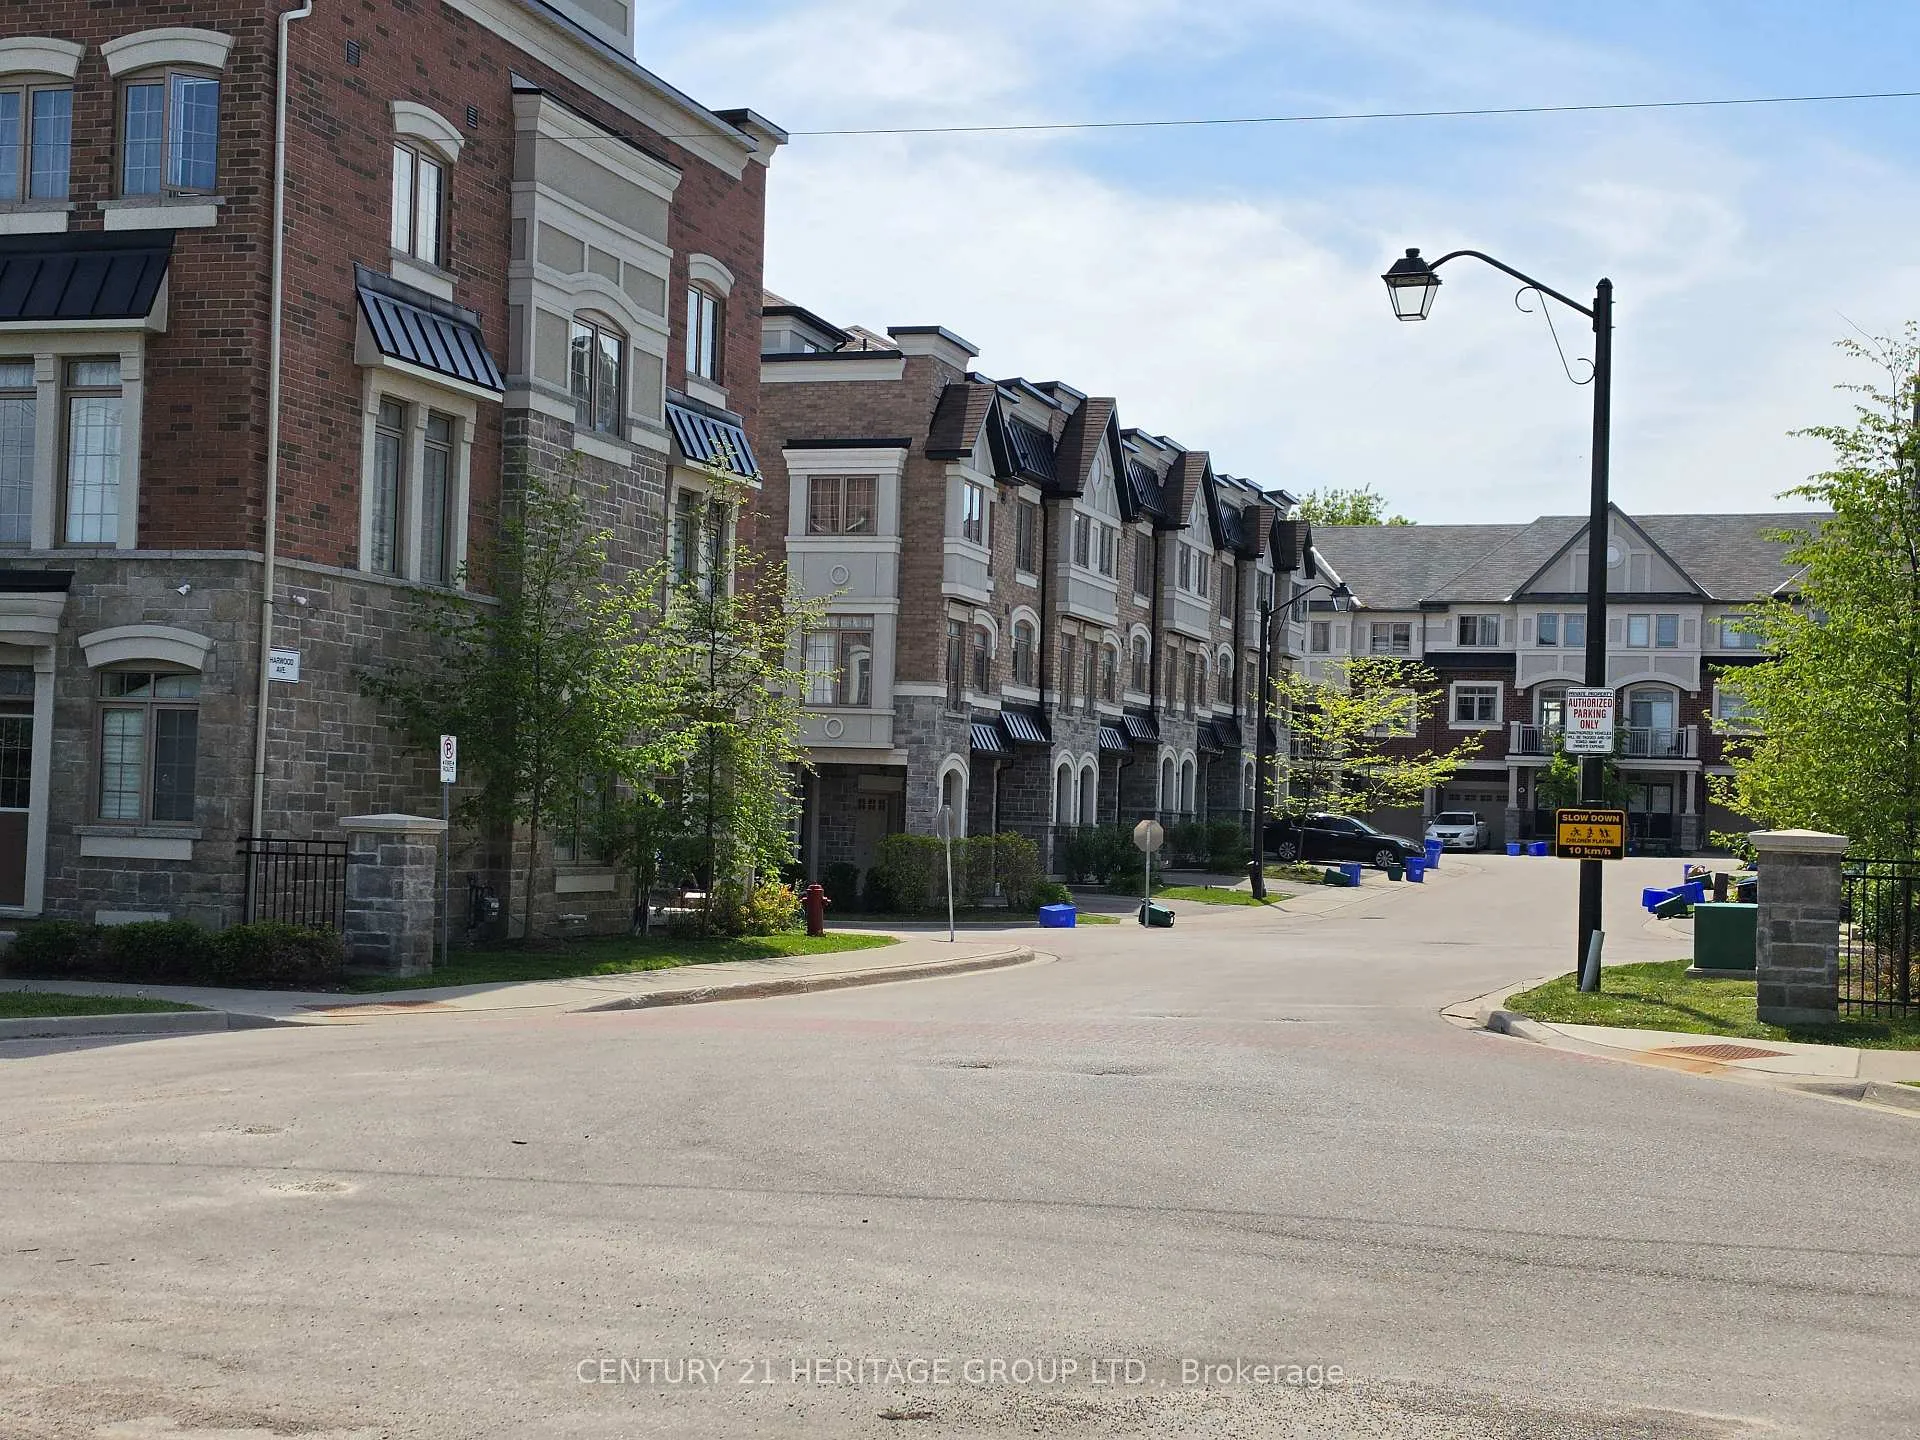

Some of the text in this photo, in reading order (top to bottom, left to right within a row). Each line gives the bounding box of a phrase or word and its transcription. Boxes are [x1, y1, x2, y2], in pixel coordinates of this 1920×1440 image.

[1568, 698, 1612, 708] AUTHORIZED
[1573, 709, 1607, 718] PARKING
[1580, 719, 1599, 729] ONLY
[1569, 846, 1611, 855] 10 km/h
